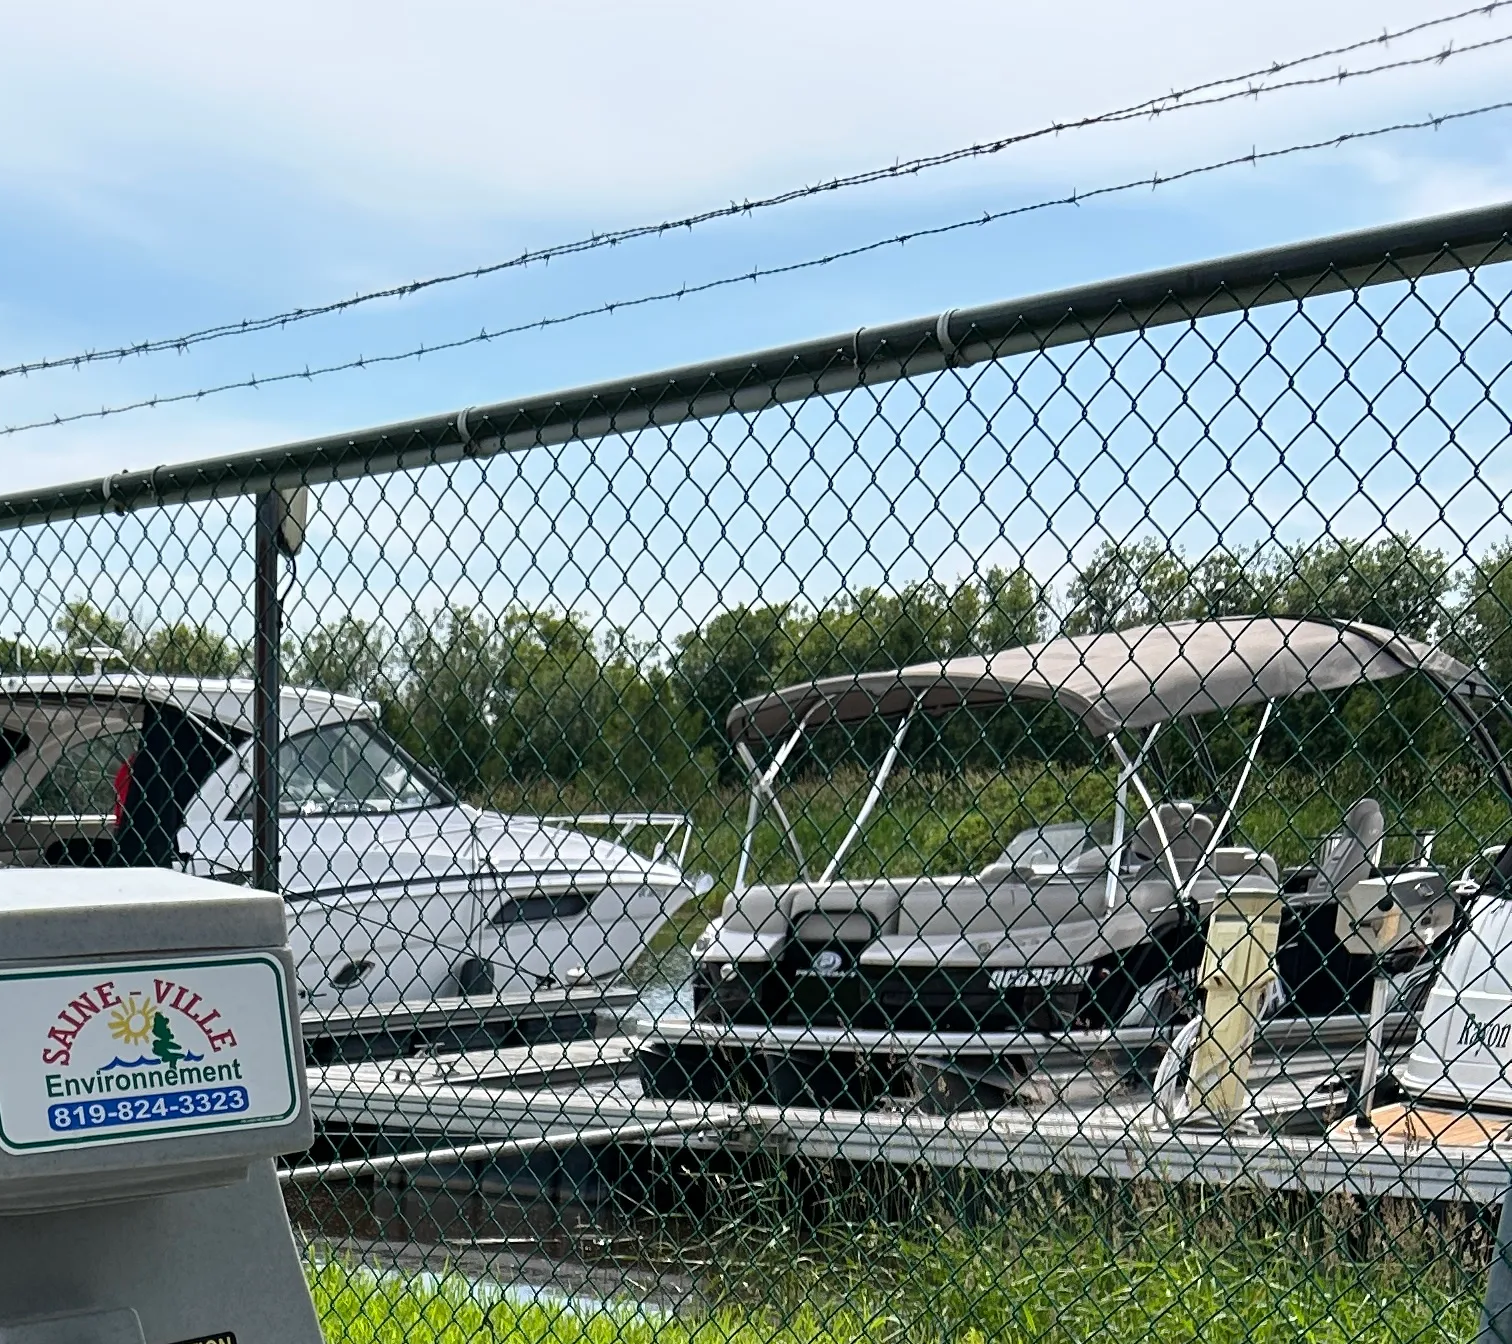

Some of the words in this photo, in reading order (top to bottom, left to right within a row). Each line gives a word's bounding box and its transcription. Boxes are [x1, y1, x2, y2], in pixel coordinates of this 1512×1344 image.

[43, 981, 123, 1066] SAINE
[153, 979, 238, 1053] VILLE
[45, 1058, 243, 1098] Environnement
[54, 1090, 245, 1128] 819-824-3323
